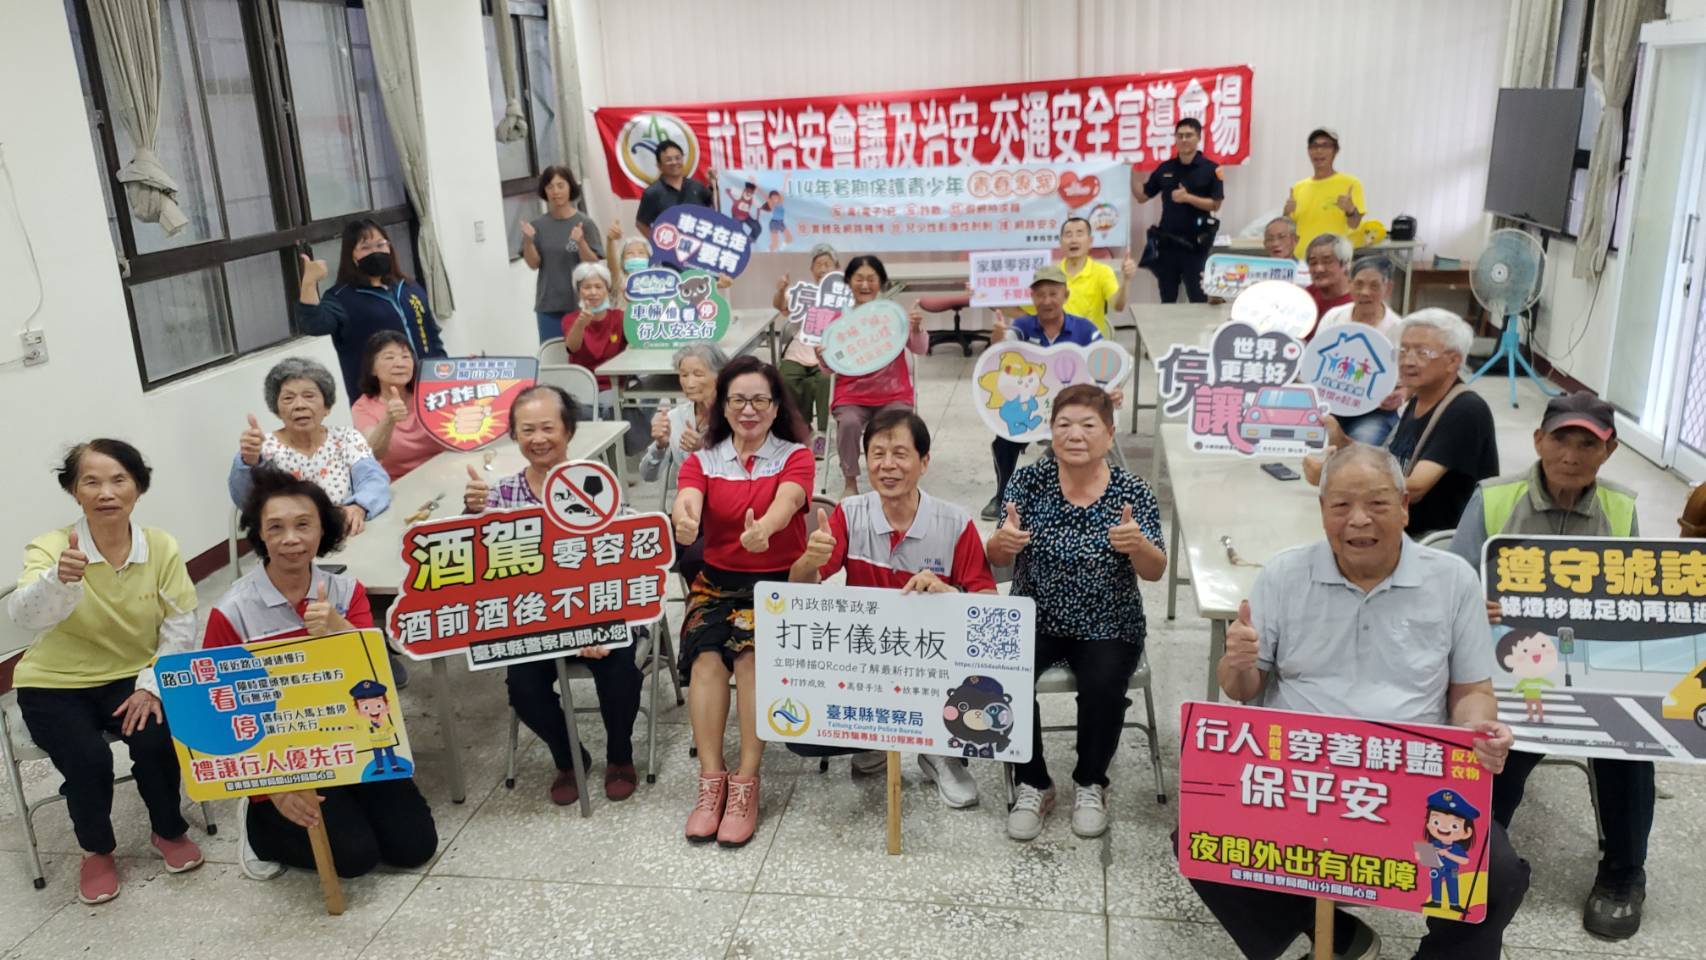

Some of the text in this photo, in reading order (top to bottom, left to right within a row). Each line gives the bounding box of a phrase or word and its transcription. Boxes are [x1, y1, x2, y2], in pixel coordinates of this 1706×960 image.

[788, 176, 964, 198] 114年暑期保護青少年
[638, 322, 717, 340] 行人安全行
[1233, 336, 1278, 360] 世界
[1158, 347, 1211, 414] 停
[1220, 360, 1287, 384] 更美好
[412, 516, 664, 591] 酒駕 零容忍
[1497, 546, 1706, 597] 遵守號誌
[397, 574, 661, 645] 酒前酒後不開車
[791, 597, 880, 616] 內政部警政署
[472, 623, 628, 662] 臺東縣警察局關心您
[776, 618, 948, 661] 打詐儀錶板
[161, 671, 191, 688] 路口
[192, 658, 219, 684] 慢
[211, 685, 237, 711] 看
[826, 703, 924, 727] 臺東縣警察局
[232, 715, 259, 740] 停
[1195, 717, 1264, 757] 行人
[1288, 729, 1444, 777] 穿著鮮豔
[192, 743, 355, 782] 禮讓行人優先行
[1240, 763, 1389, 823] 保平安
[1190, 832, 1418, 891] 夜間外出有保障
